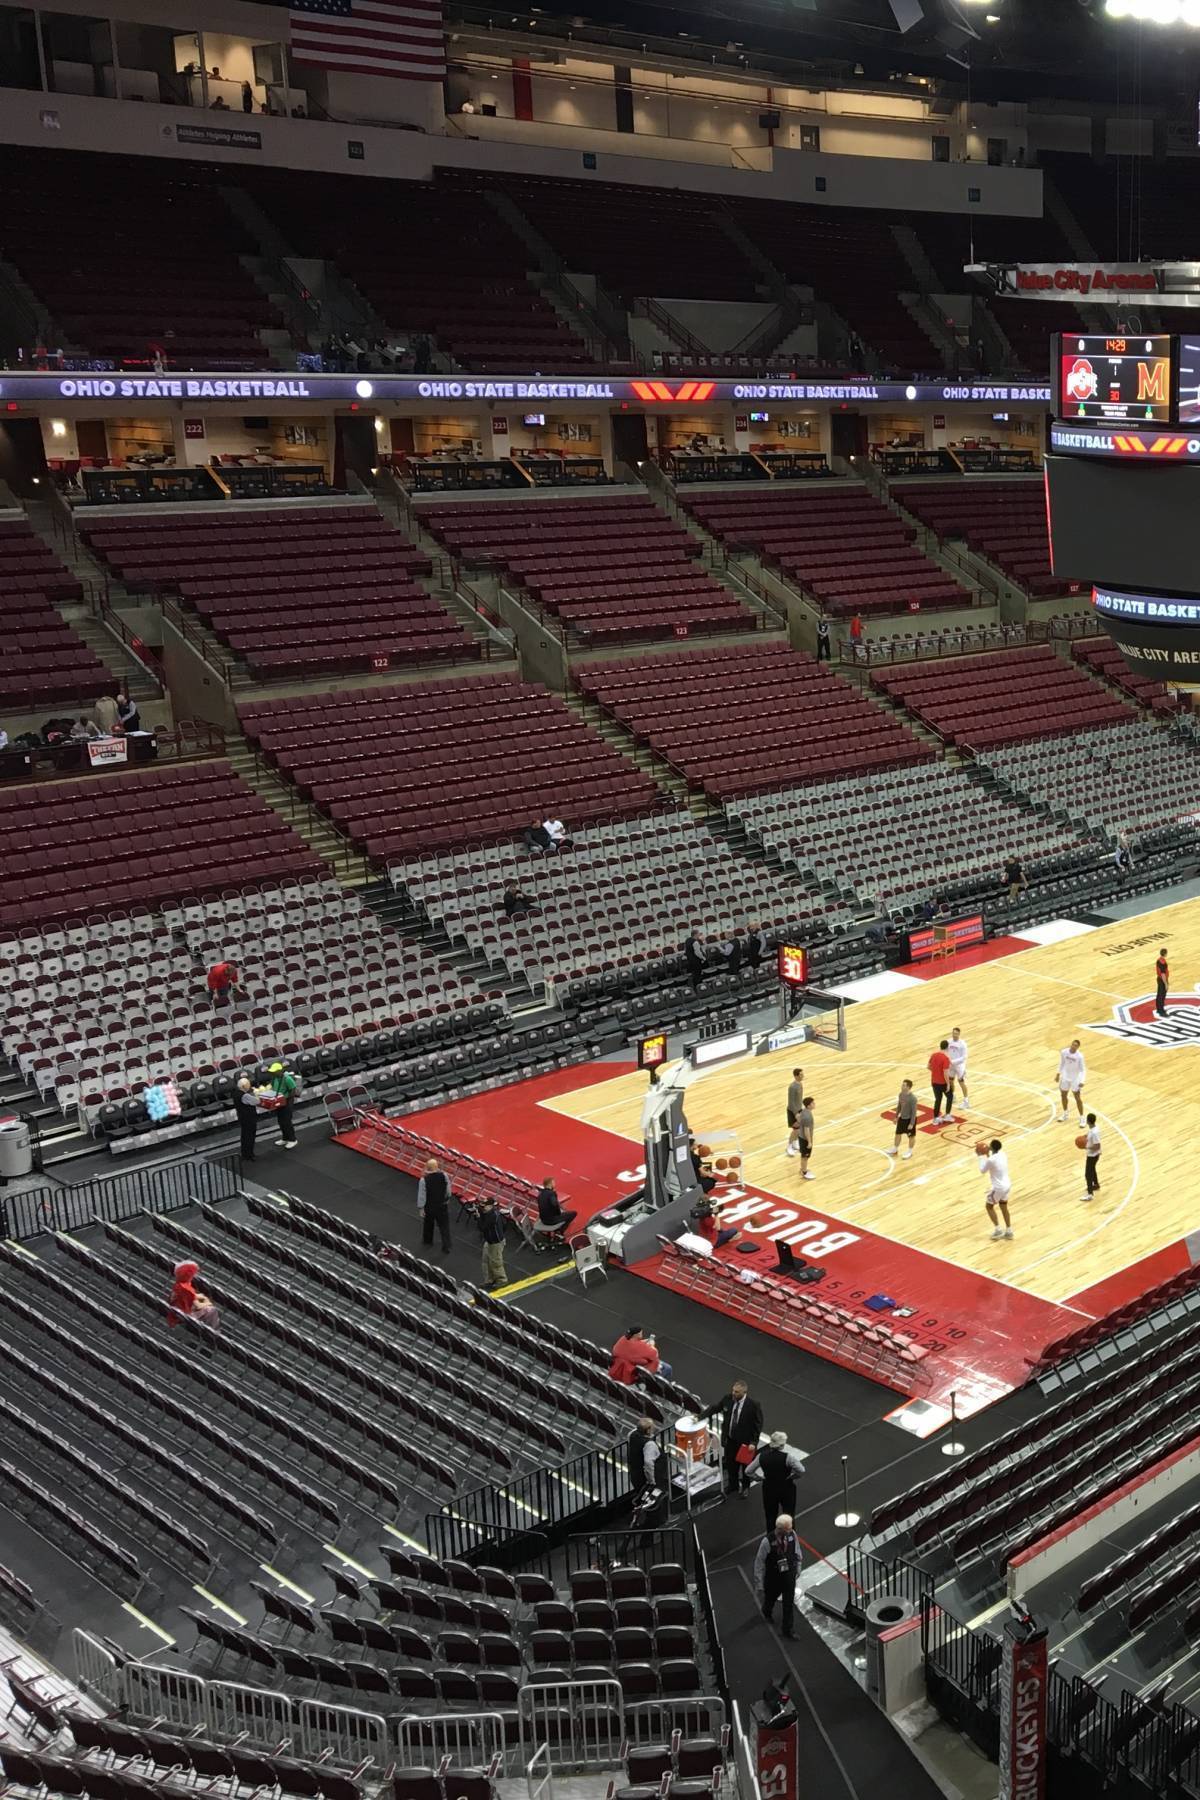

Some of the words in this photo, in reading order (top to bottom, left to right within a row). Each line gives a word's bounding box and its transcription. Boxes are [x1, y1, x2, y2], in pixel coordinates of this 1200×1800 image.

[178, 129, 206, 138] Athletes
[232, 133, 259, 143] Athletes
[1054, 270, 1092, 294] City
[1091, 270, 1157, 290] Arena
[1078, 339, 1086, 351] 0
[1106, 340, 1126, 352] 14:29
[1145, 340, 1153, 352] 0
[60, 380, 116, 396] OHIO
[120, 380, 183, 397] STATE
[187, 380, 310, 397] BASKETBALL
[1137, 362, 1166, 400] M
[418, 382, 462, 397] OHIO
[465, 382, 514, 398] STATE
[516, 382, 614, 398] BASKETBALL
[734, 384, 767, 398] OHIO
[768, 385, 804, 398] STATE
[806, 385, 879, 399] BASKETBALL
[942, 387, 970, 399] OHIO
[971, 387, 1009, 399] STATE
[186, 424, 203, 434] 222
[493, 422, 508, 431] 223
[1058, 433, 1115, 449] BASKETBALL
[1112, 597, 1146, 615] STATE
[676, 627, 688, 635] 123
[374, 658, 389, 667] 122
[1142, 648, 1169, 662] CITY
[1132, 931, 1174, 947] VALUE
[1100, 942, 1136, 957] CITY
[782, 956, 801, 980] 30
[758, 1254, 776, 1265] 2
[826, 1280, 842, 1290] 5
[849, 1290, 865, 1300] 6
[921, 1318, 938, 1328] 9
[945, 1327, 968, 1339] 10
[921, 1339, 948, 1352] 20
